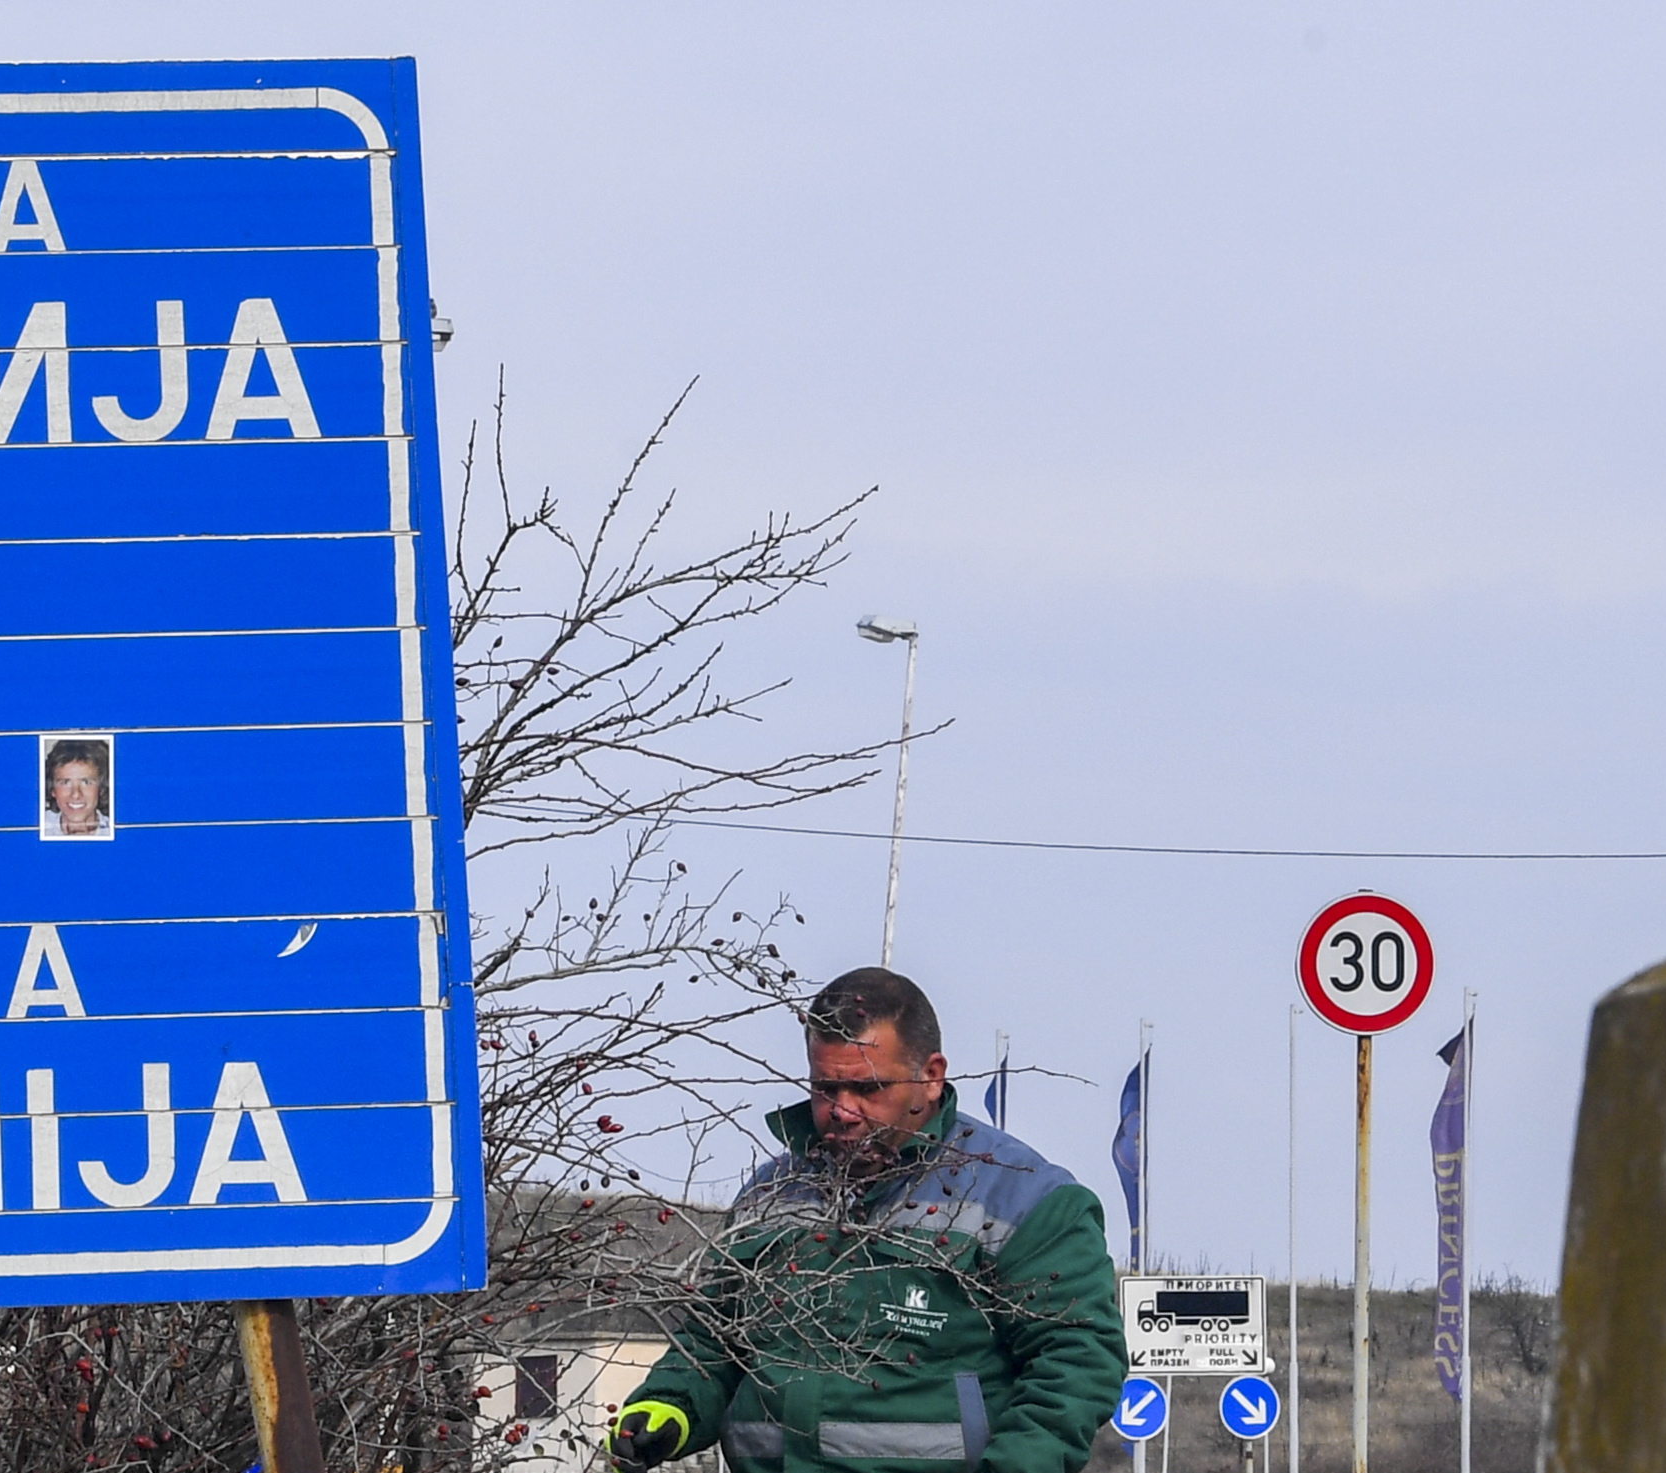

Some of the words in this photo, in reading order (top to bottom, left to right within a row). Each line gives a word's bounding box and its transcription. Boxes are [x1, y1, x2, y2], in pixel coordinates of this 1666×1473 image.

[1329, 931, 1405, 992] 30
[1165, 1281, 1252, 1291] ПРИОРИТЕТ
[1184, 1333, 1258, 1344] PRIORITY
[1150, 1348, 1185, 1357] EMPTY
[1209, 1348, 1235, 1356] FULL
[1150, 1358, 1190, 1366] ПРАЗЕН
